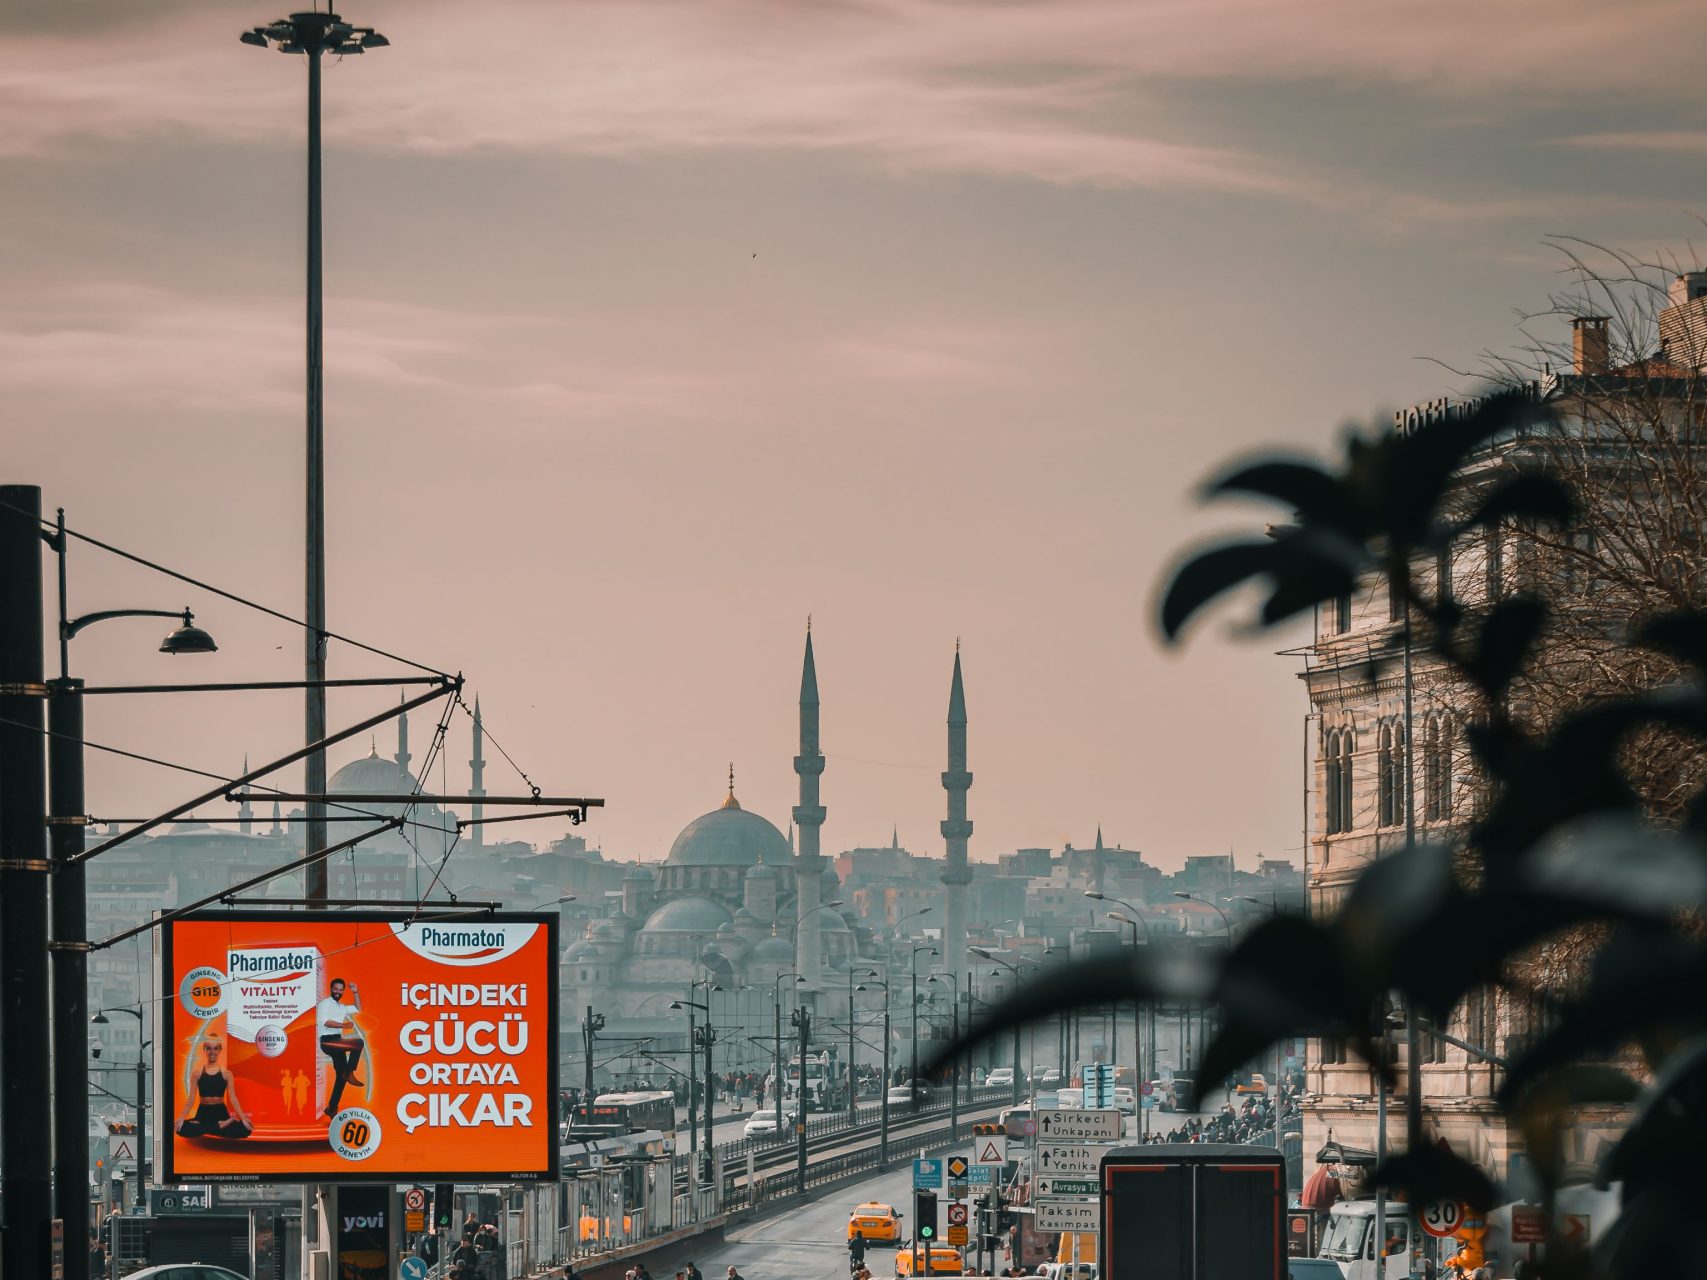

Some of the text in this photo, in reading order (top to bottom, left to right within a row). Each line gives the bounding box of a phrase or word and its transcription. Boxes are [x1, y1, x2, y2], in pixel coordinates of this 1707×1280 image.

[422, 927, 505, 947] Pharmaton
[230, 952, 313, 972] Pharmaton
[190, 969, 221, 980] GINSENG
[192, 986, 220, 997] G115
[240, 986, 297, 997] VITALITY
[401, 983, 527, 1010] İÇİNDEKİ
[400, 1013, 529, 1055] GÜCÜ
[409, 1062, 520, 1085] ORTAYA
[338, 1113, 348, 1121] 60
[396, 1093, 533, 1134] ÇIKAR
[1053, 1113, 1106, 1123] Sirkeci
[343, 1121, 368, 1147] 60
[1053, 1127, 1112, 1138] Unkapanı
[1053, 1148, 1090, 1158] Fatih
[1053, 1182, 1086, 1193] Avrasya
[1040, 1206, 1092, 1216] Taksim
[1428, 1202, 1456, 1224] 30
[343, 1211, 384, 1233] yovi
[1040, 1220, 1099, 1229] Kasımpaş
